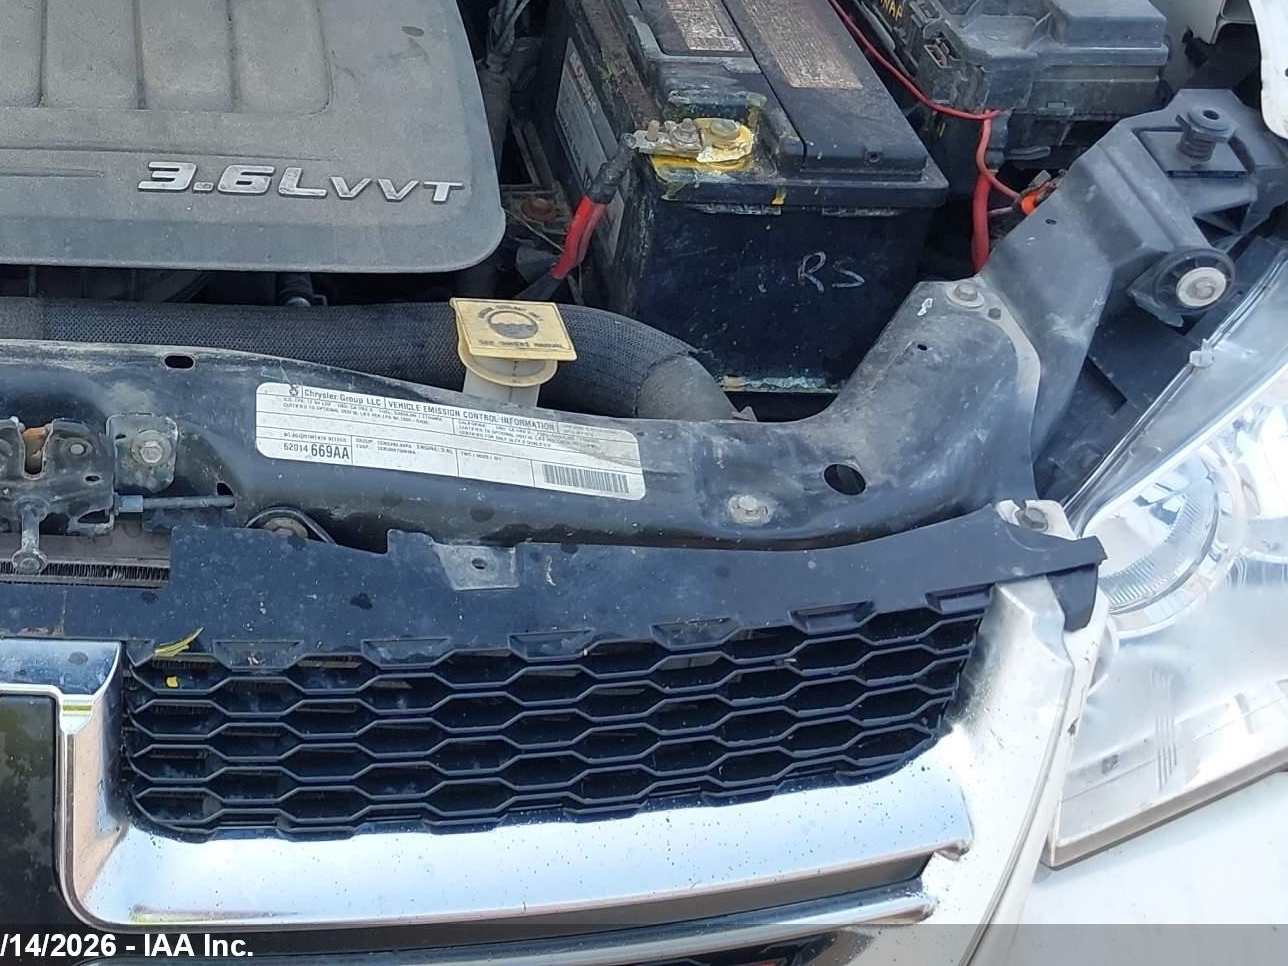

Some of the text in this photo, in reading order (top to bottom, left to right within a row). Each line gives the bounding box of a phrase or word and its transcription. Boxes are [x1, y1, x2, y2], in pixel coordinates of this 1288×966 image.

[304, 389, 338, 402] Chrysler
[340, 393, 364, 406] Group
[366, 396, 381, 407] LLC
[388, 400, 421, 412] VEHICLE
[423, 405, 461, 418] EMISSION
[463, 411, 498, 423] CONTROL
[501, 416, 556, 432] INFORMATION
[310, 443, 350, 460] 669AA
